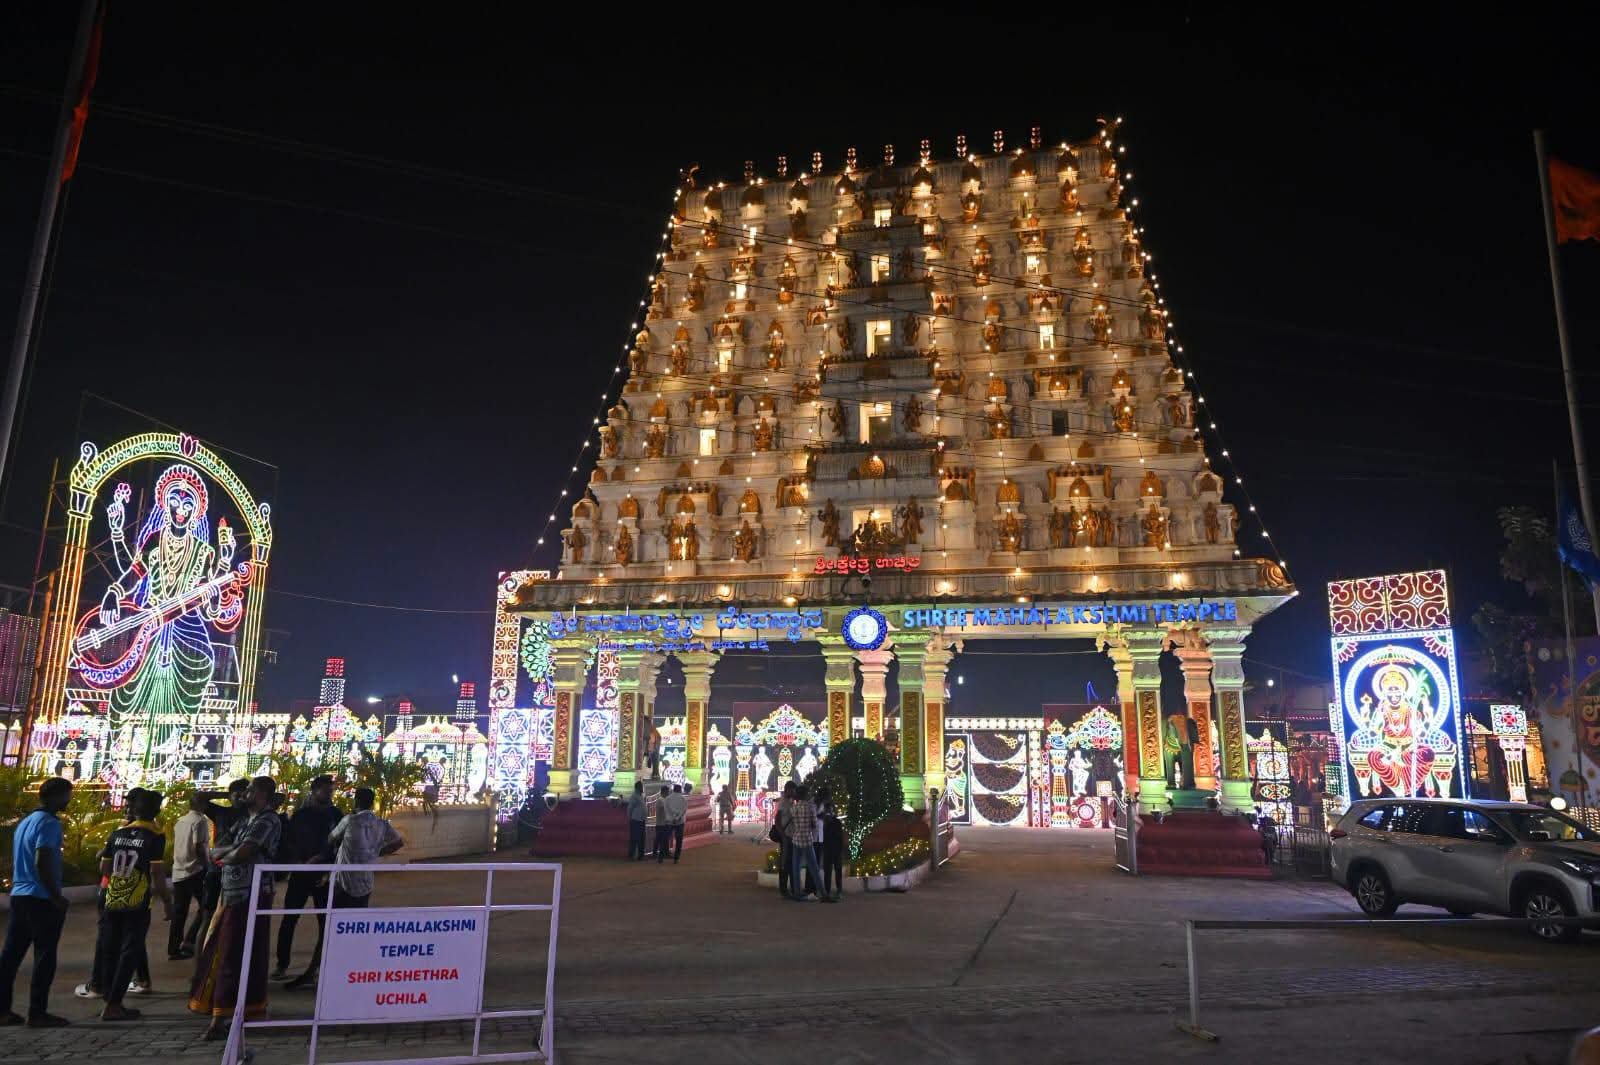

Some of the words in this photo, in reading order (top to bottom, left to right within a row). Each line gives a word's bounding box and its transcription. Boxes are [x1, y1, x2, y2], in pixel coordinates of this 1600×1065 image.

[904, 608, 967, 628] SHREE
[973, 604, 1147, 626] MAHALAKSHMI
[1152, 602, 1236, 622] TEMPLE
[113, 850, 138, 878] 07
[336, 921, 370, 934] SHRI
[373, 919, 476, 934] MAHALAKSHMI
[380, 943, 435, 958] TEMPLE
[347, 970, 381, 984] SHRI
[385, 968, 459, 982] KSHETHRA
[375, 992, 427, 1005] UCHILA
